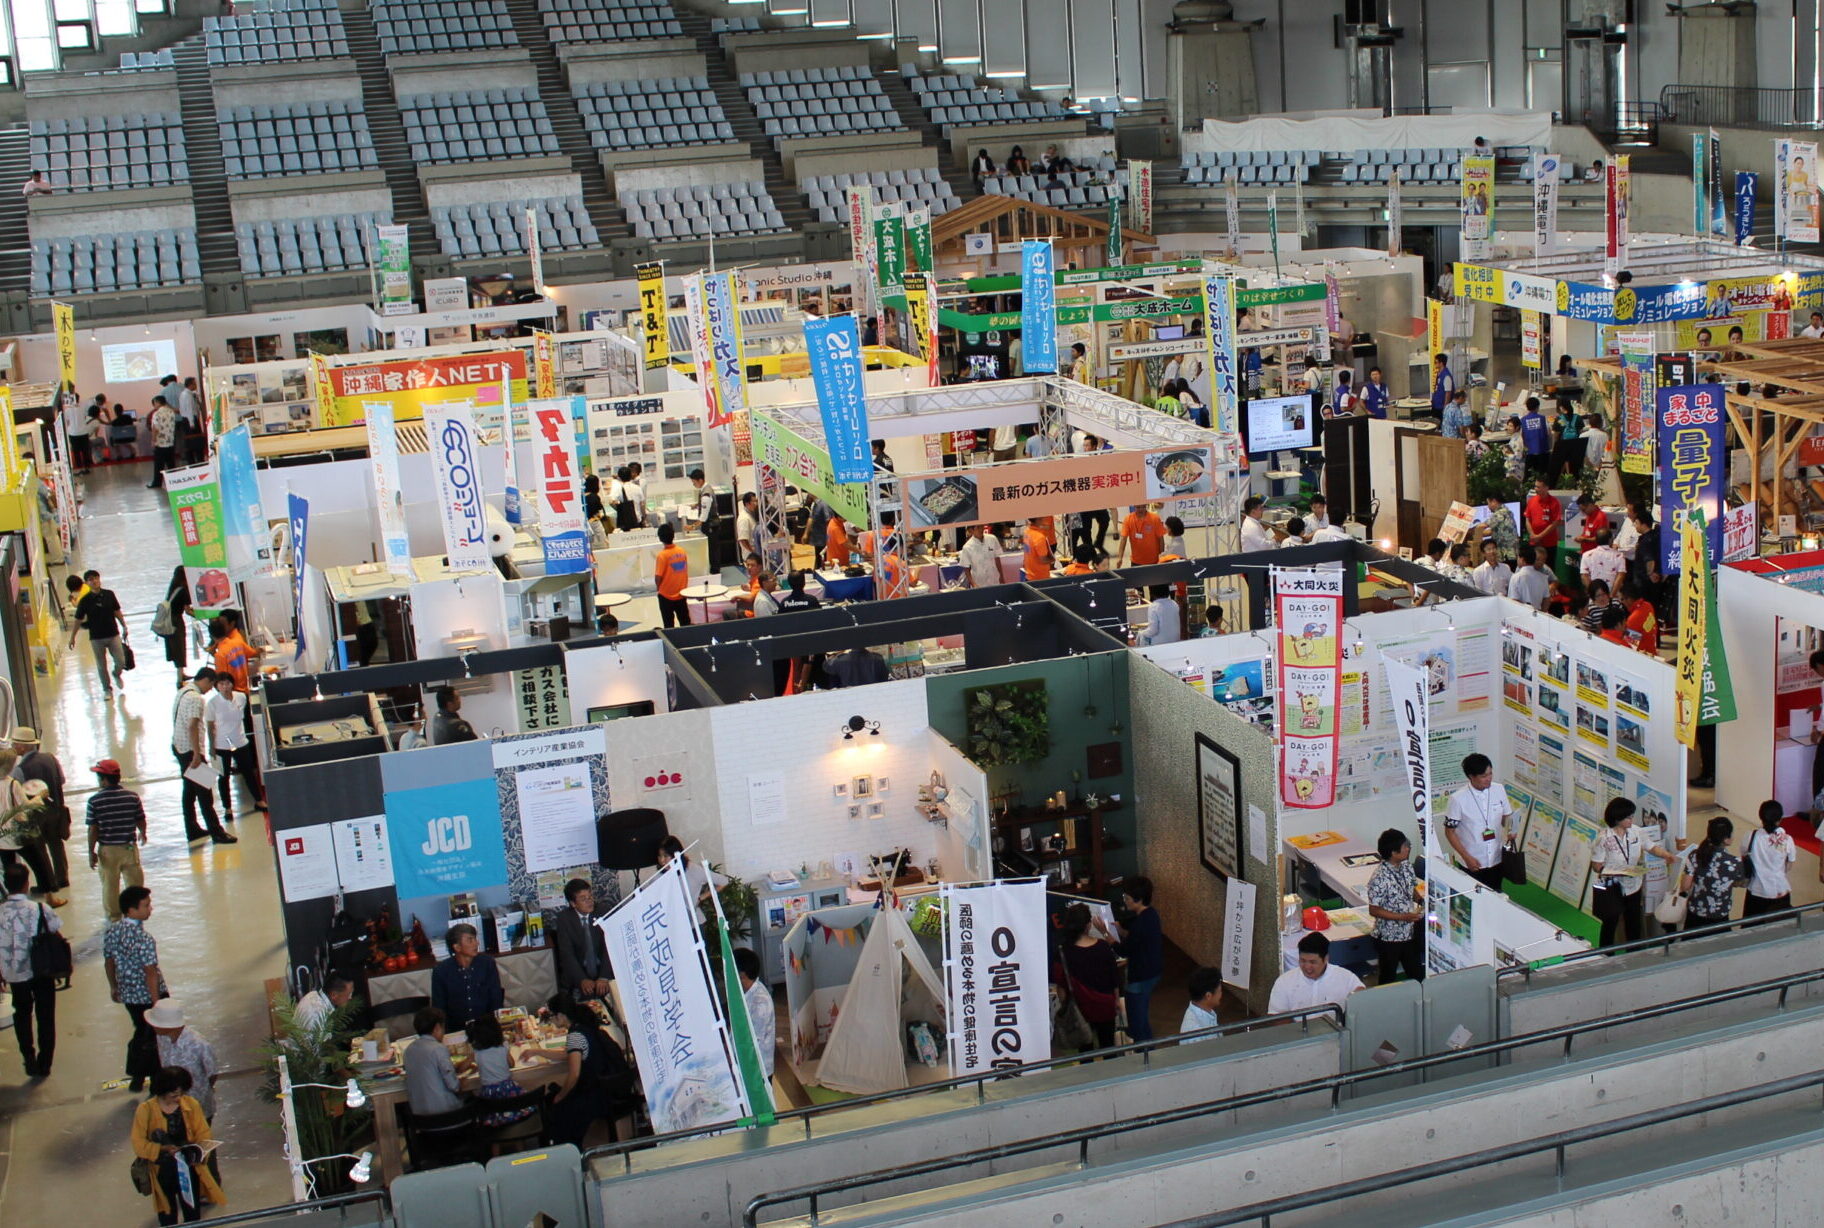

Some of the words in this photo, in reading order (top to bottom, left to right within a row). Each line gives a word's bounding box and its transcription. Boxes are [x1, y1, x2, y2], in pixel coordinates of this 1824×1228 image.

[777, 272, 812, 285] Studio
[813, 270, 832, 281] 沖縄
[1462, 267, 1494, 283] 電化相談
[1463, 284, 1494, 298] 受付中
[1134, 299, 1192, 315] 大成ホーム
[1569, 305, 1614, 319] シミュレーション
[1637, 303, 1707, 324] シミュレーション
[641, 289, 659, 354] T&T
[343, 362, 499, 396] 沖縄家作人NET
[1668, 393, 1686, 413] 家
[1694, 392, 1713, 411] 中
[1662, 407, 1719, 428] まるごと
[991, 470, 1141, 503] 最新のガス機器実演中!
[1293, 579, 1339, 592] 大同火災
[784, 599, 810, 609] Paloma
[1289, 603, 1330, 612] DAY-GO!
[1681, 567, 1700, 685] 大同火災
[1291, 671, 1329, 682] DAY-GO!
[519, 667, 541, 729] ご相談下さ
[539, 667, 560, 726] ガス会社に
[513, 738, 585, 759] インテリア産業協会
[1290, 741, 1328, 752] DAY-GO!
[421, 814, 473, 857] JCD
